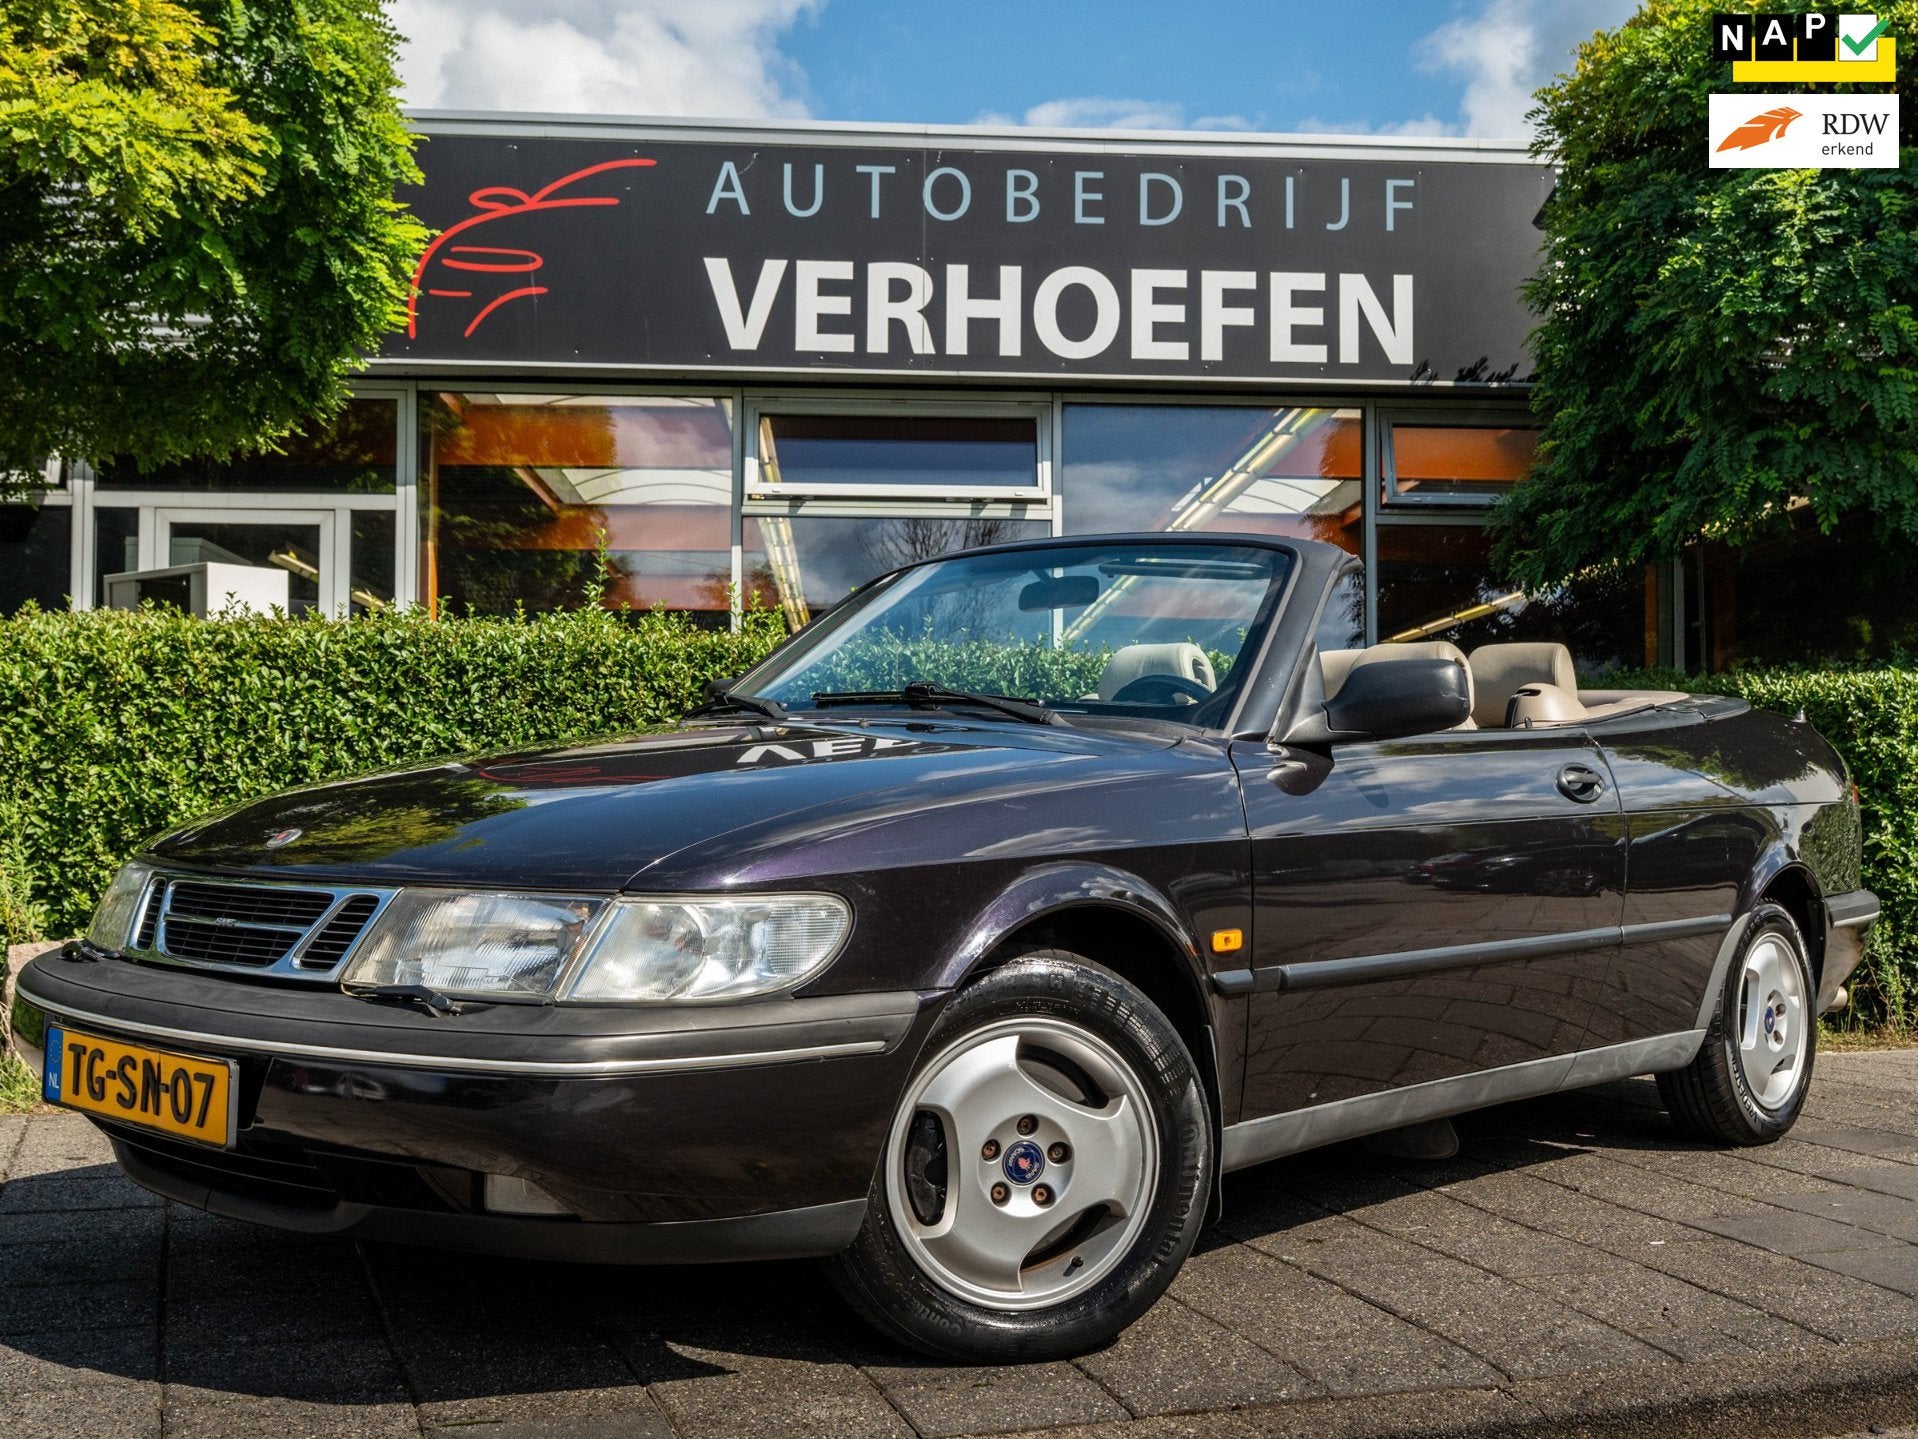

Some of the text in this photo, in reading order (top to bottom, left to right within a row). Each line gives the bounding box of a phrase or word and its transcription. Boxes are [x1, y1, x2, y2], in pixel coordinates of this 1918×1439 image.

[705, 161, 1416, 231] AUTOBEDRIJF
[702, 256, 1414, 365] VERHOEFEN
[49, 1071, 60, 1089] NL
[68, 1043, 215, 1128] TG-SN-07
